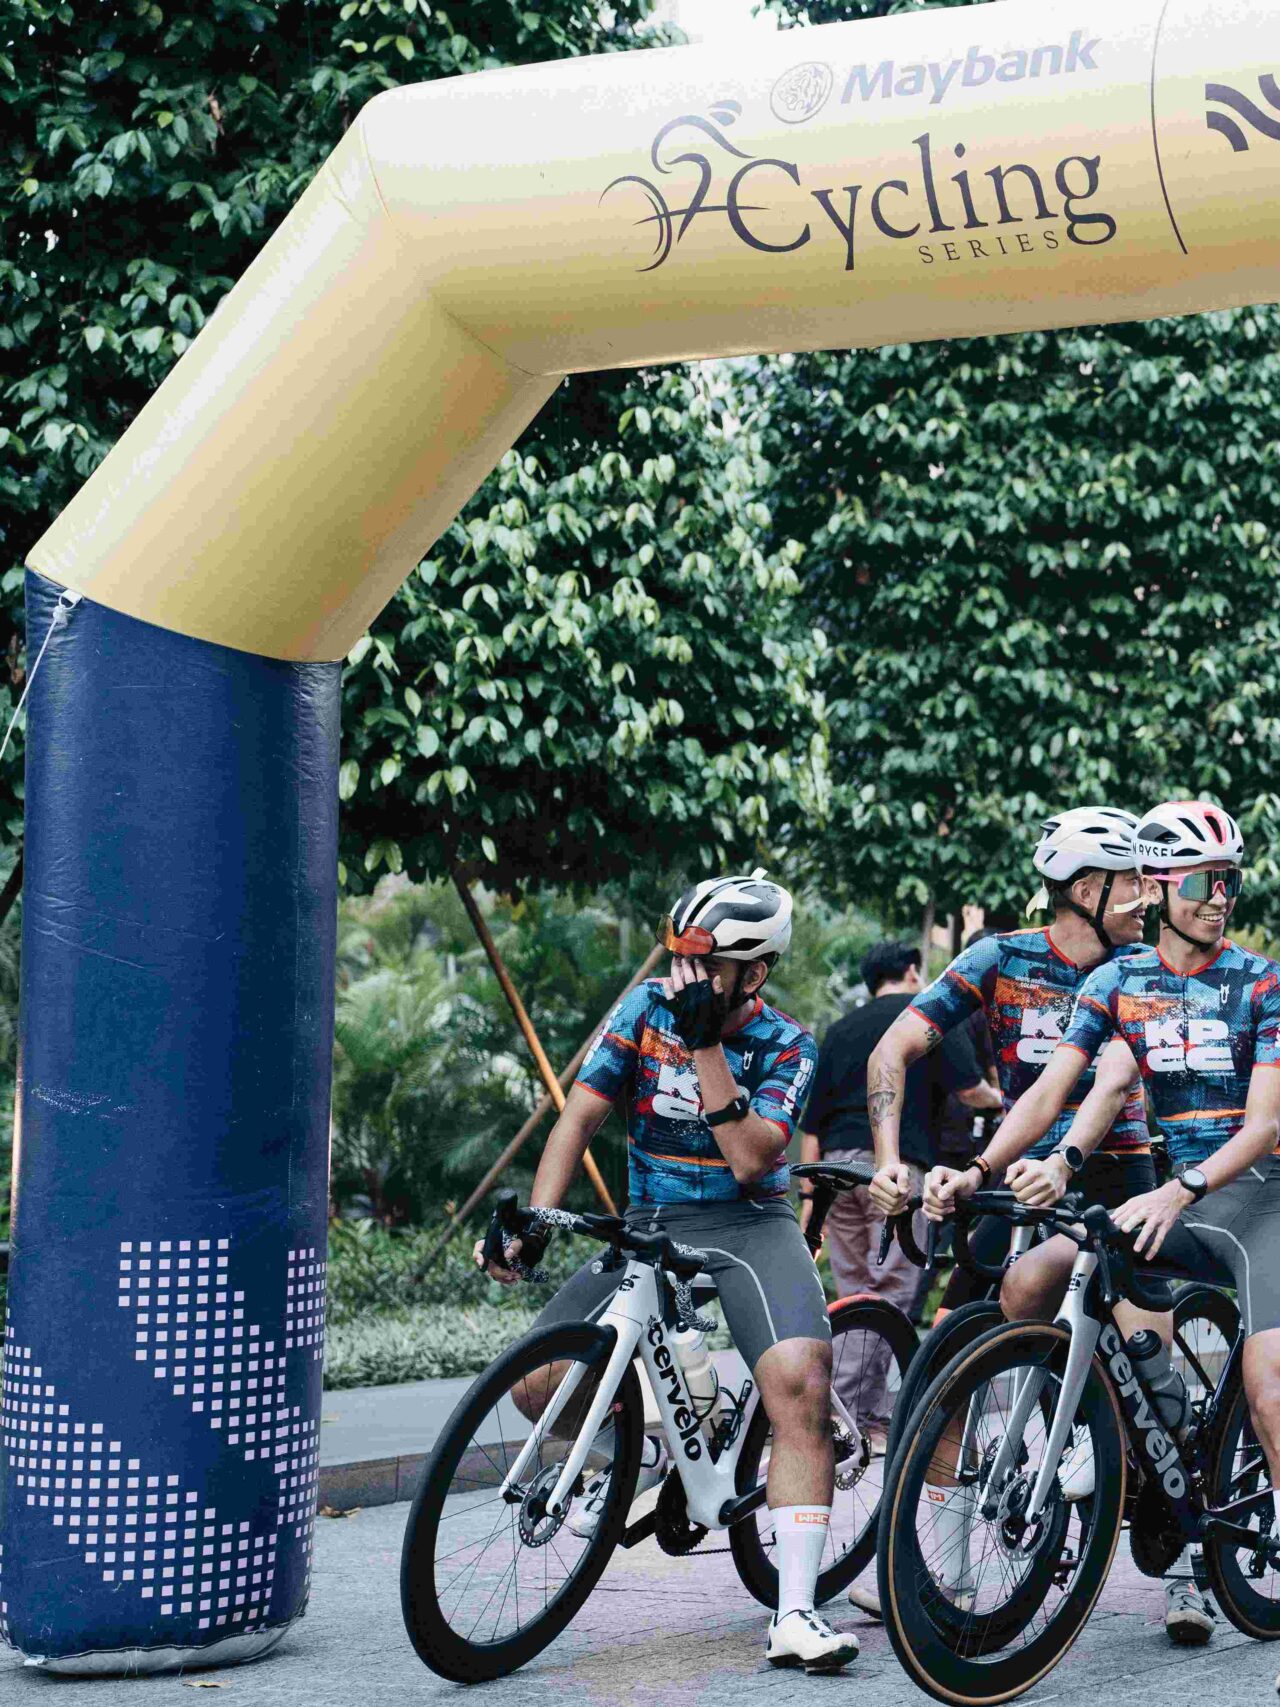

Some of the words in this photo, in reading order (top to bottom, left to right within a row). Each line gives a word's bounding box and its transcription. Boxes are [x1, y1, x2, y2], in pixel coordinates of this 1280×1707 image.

[841, 30, 1101, 104] Maybank
[727, 132, 1118, 271] Cycling
[917, 230, 1060, 265] SERIES
